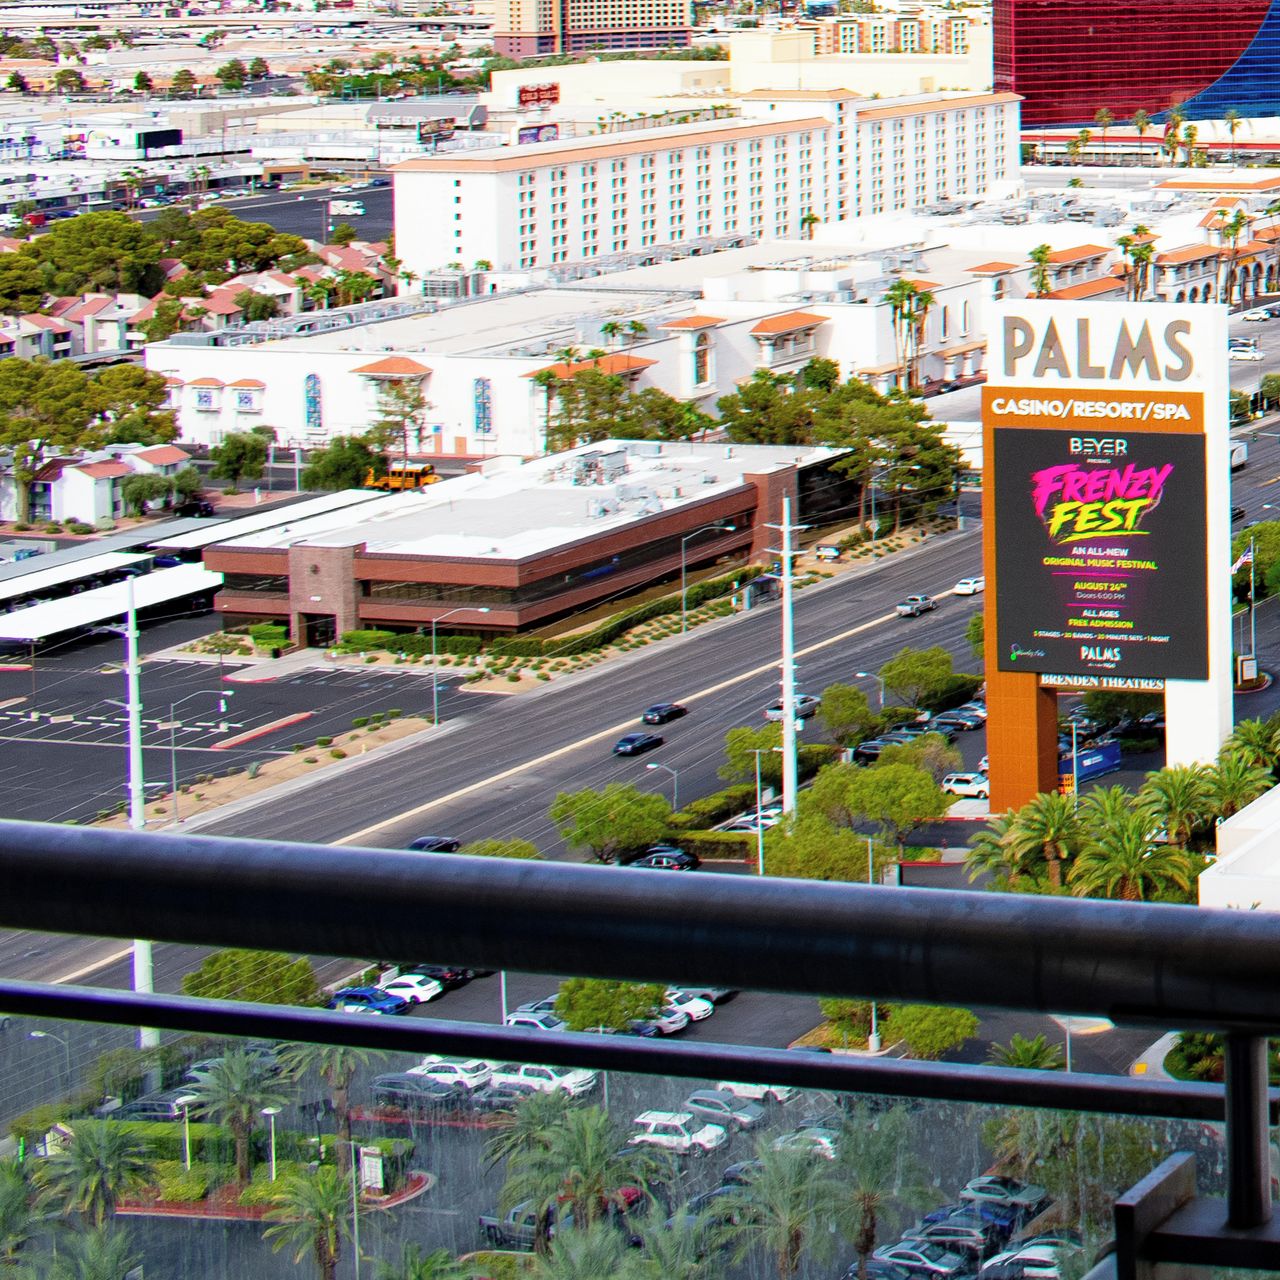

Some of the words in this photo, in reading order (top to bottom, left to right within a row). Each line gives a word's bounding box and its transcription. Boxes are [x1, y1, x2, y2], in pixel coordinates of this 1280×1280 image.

[1003, 315, 1194, 382] PALMS
[992, 398, 1192, 421] CASINO/RESORT/SPA
[1069, 437, 1128, 453] BEYER
[1030, 463, 1175, 517] FRENZY
[1046, 497, 1153, 538] FEST
[1072, 546, 1086, 556] AN
[1043, 557, 1086, 567] ORIGINAL
[1087, 559, 1115, 568] MUSIC
[1116, 560, 1158, 570] FESTIVAL
[1074, 582, 1108, 591] AUGUST
[1082, 609, 1098, 617] ALL
[1098, 610, 1120, 618] AGES
[1068, 618, 1088, 627] FREE
[1089, 619, 1134, 629] ADMISSION
[1081, 645, 1121, 661] PALMS
[1041, 674, 1098, 688] BRENDEN
[1099, 675, 1164, 690] THEATRES
